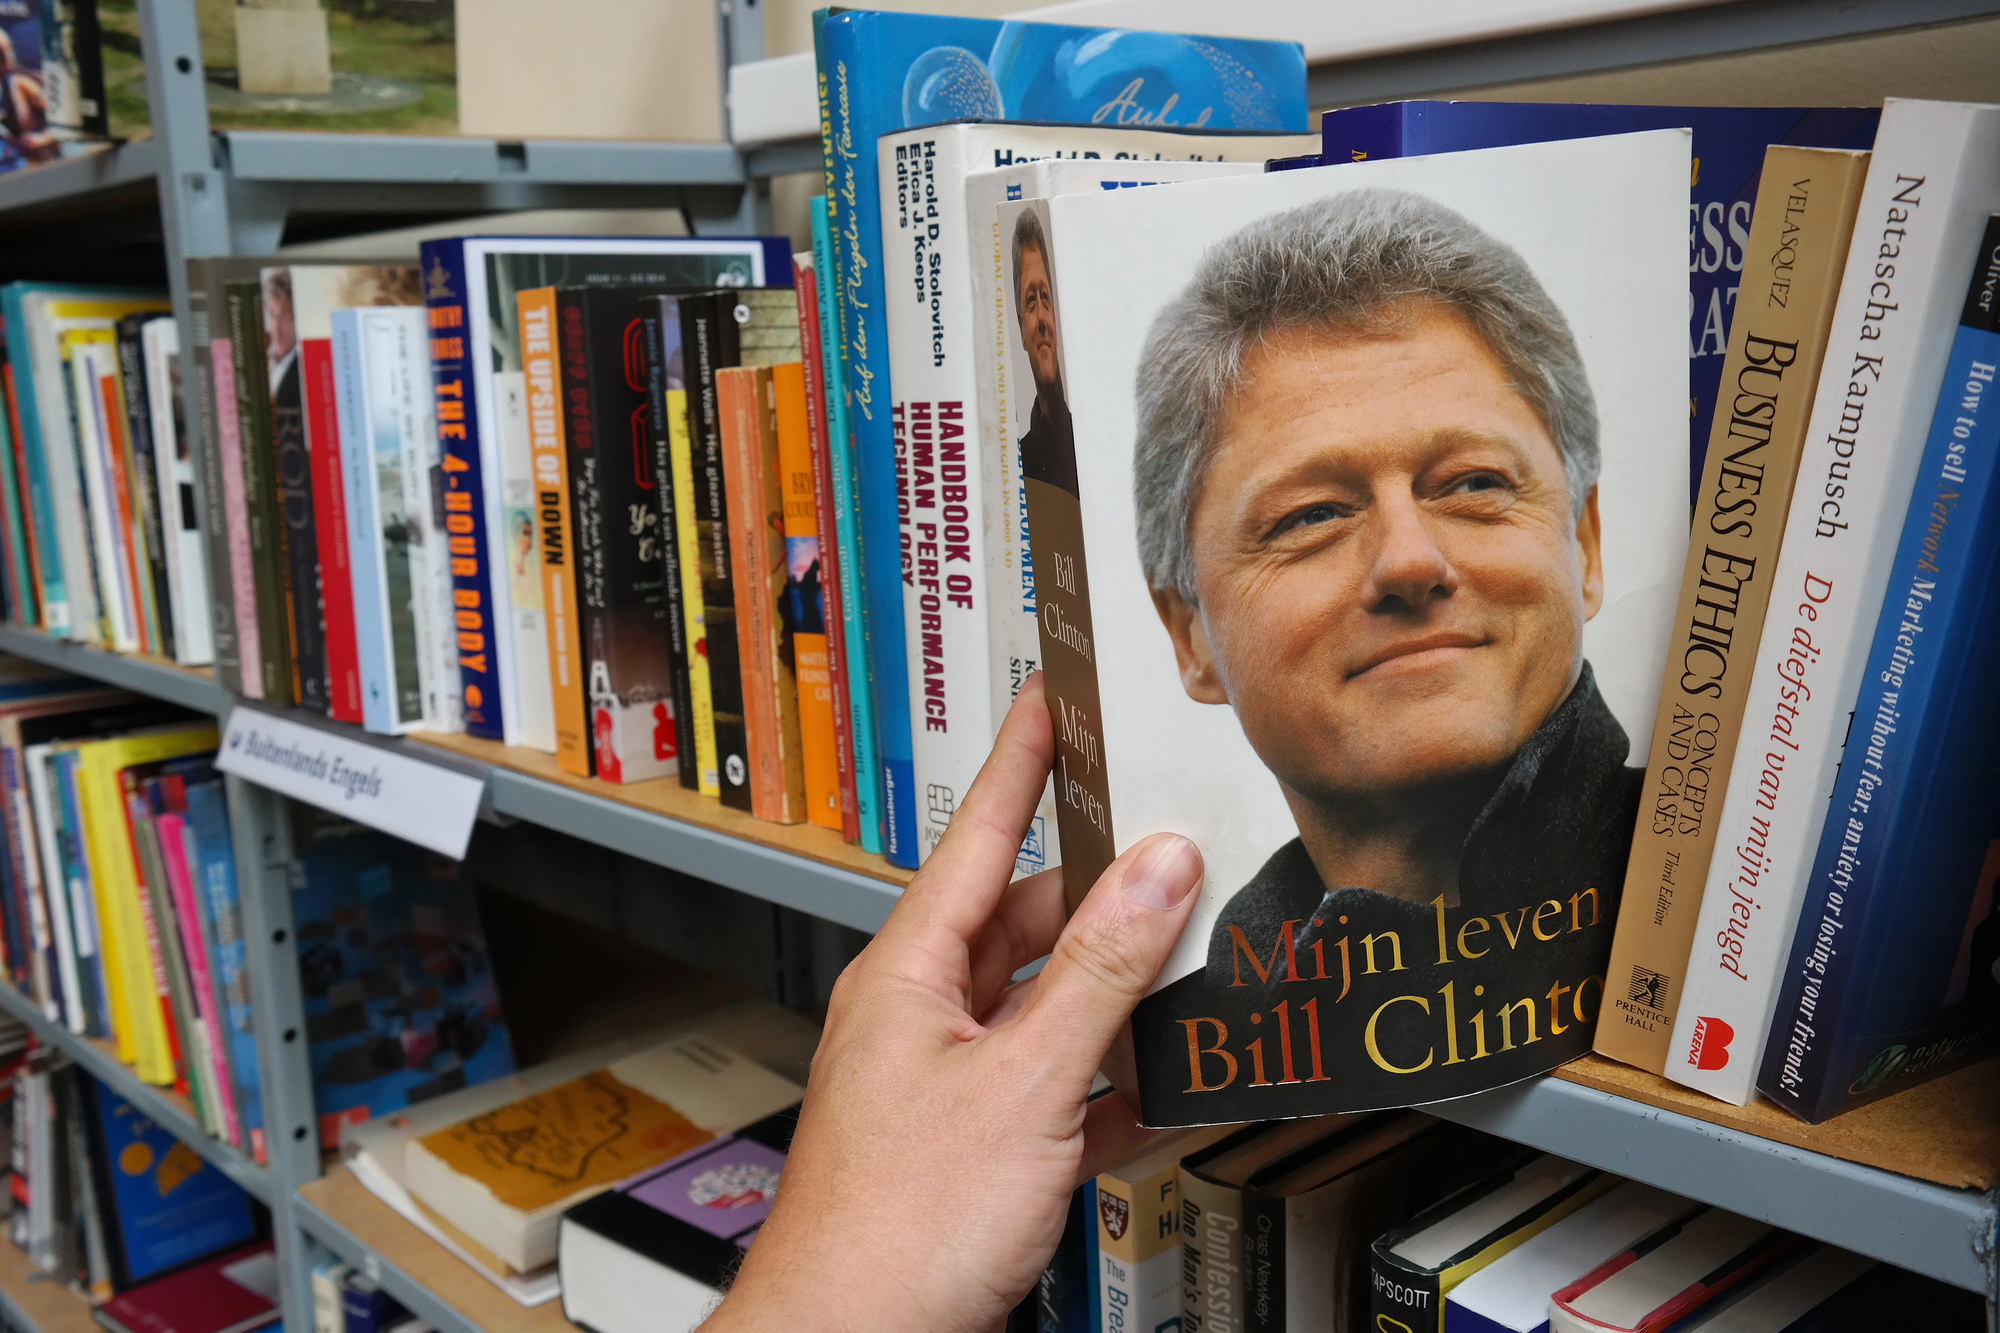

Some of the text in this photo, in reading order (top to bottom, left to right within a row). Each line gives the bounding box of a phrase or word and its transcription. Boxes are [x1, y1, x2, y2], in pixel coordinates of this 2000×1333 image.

[895, 146, 908, 228] Editors
[909, 143, 926, 303] Erica J. Keeps
[815, 239, 828, 306] Amerika
[836, 60, 874, 420] Auf den Flügeln der Fantasie
[924, 141, 945, 367] Harold D. Stolovitch
[1768, 177, 1811, 309] VELASQUEZ
[524, 305, 550, 354] THE
[435, 379, 467, 441] THE
[528, 358, 558, 450] UPSIDE
[992, 222, 1012, 568] GLOBAL CHANGES AND STRATEGIES IN 2000 AD
[1964, 360, 1997, 414] How
[655, 440, 667, 466] Het
[696, 318, 727, 579] Jeannette Walls Het glazen kasteel
[1941, 442, 1967, 484] sell
[1953, 417, 1978, 439] to
[535, 455, 561, 486] OF
[656, 469, 673, 513] geluid
[892, 402, 914, 588] TECHNOLOGY
[938, 401, 973, 611] HANDBOOK OF
[441, 453, 478, 577] 4-HOUR
[540, 491, 564, 567] DOWN
[663, 515, 673, 541] van
[1681, 330, 1799, 700] BUSINESS ETHICS
[1917, 482, 1962, 574] Network
[665, 543, 680, 601] vallende
[839, 545, 853, 621] Gernhardt
[910, 402, 947, 734] HUMAN PERFORMANCE
[1716, 173, 1926, 982] Natascha Kampusch De diefstal van mijn jeugd
[453, 588, 488, 674] BODY
[669, 603, 681, 654] sneeuw
[1044, 552, 1092, 663] Bill Clinton
[1881, 574, 1936, 690] Marketing
[244, 729, 383, 801] Buitenlands Engels
[853, 704, 865, 774] Ellermann
[1057, 695, 1109, 837] Mijn leven
[1865, 691, 1900, 770] without
[1652, 702, 1696, 838] AND CASES
[1677, 712, 1721, 837] CONCEPTS
[1848, 769, 1883, 814] fear,
[884, 767, 898, 854] Ravensburger
[1654, 850, 1681, 926] Third Edition
[1828, 817, 1864, 892] anxiety
[1827, 892, 1844, 917] or
[1225, 887, 1601, 1004] Mijn leven
[1805, 917, 1844, 977] losing
[1615, 998, 1671, 1027] PRENTICE
[1625, 1013, 1657, 1034] HALL
[1799, 969, 1823, 1022] your
[1175, 997, 1331, 1094] Bill
[1687, 1016, 1706, 1067] ARENA
[1779, 1019, 1816, 1098] friends!
[1912, 1024, 1991, 1060] natural
[1183, 1198, 1201, 1238] One
[1105, 1258, 1126, 1283] The
[1183, 1243, 1201, 1304] Man's
[1255, 1214, 1272, 1327] Chas Newkey-
[1371, 1266, 1431, 1309] TAPSCOTT
